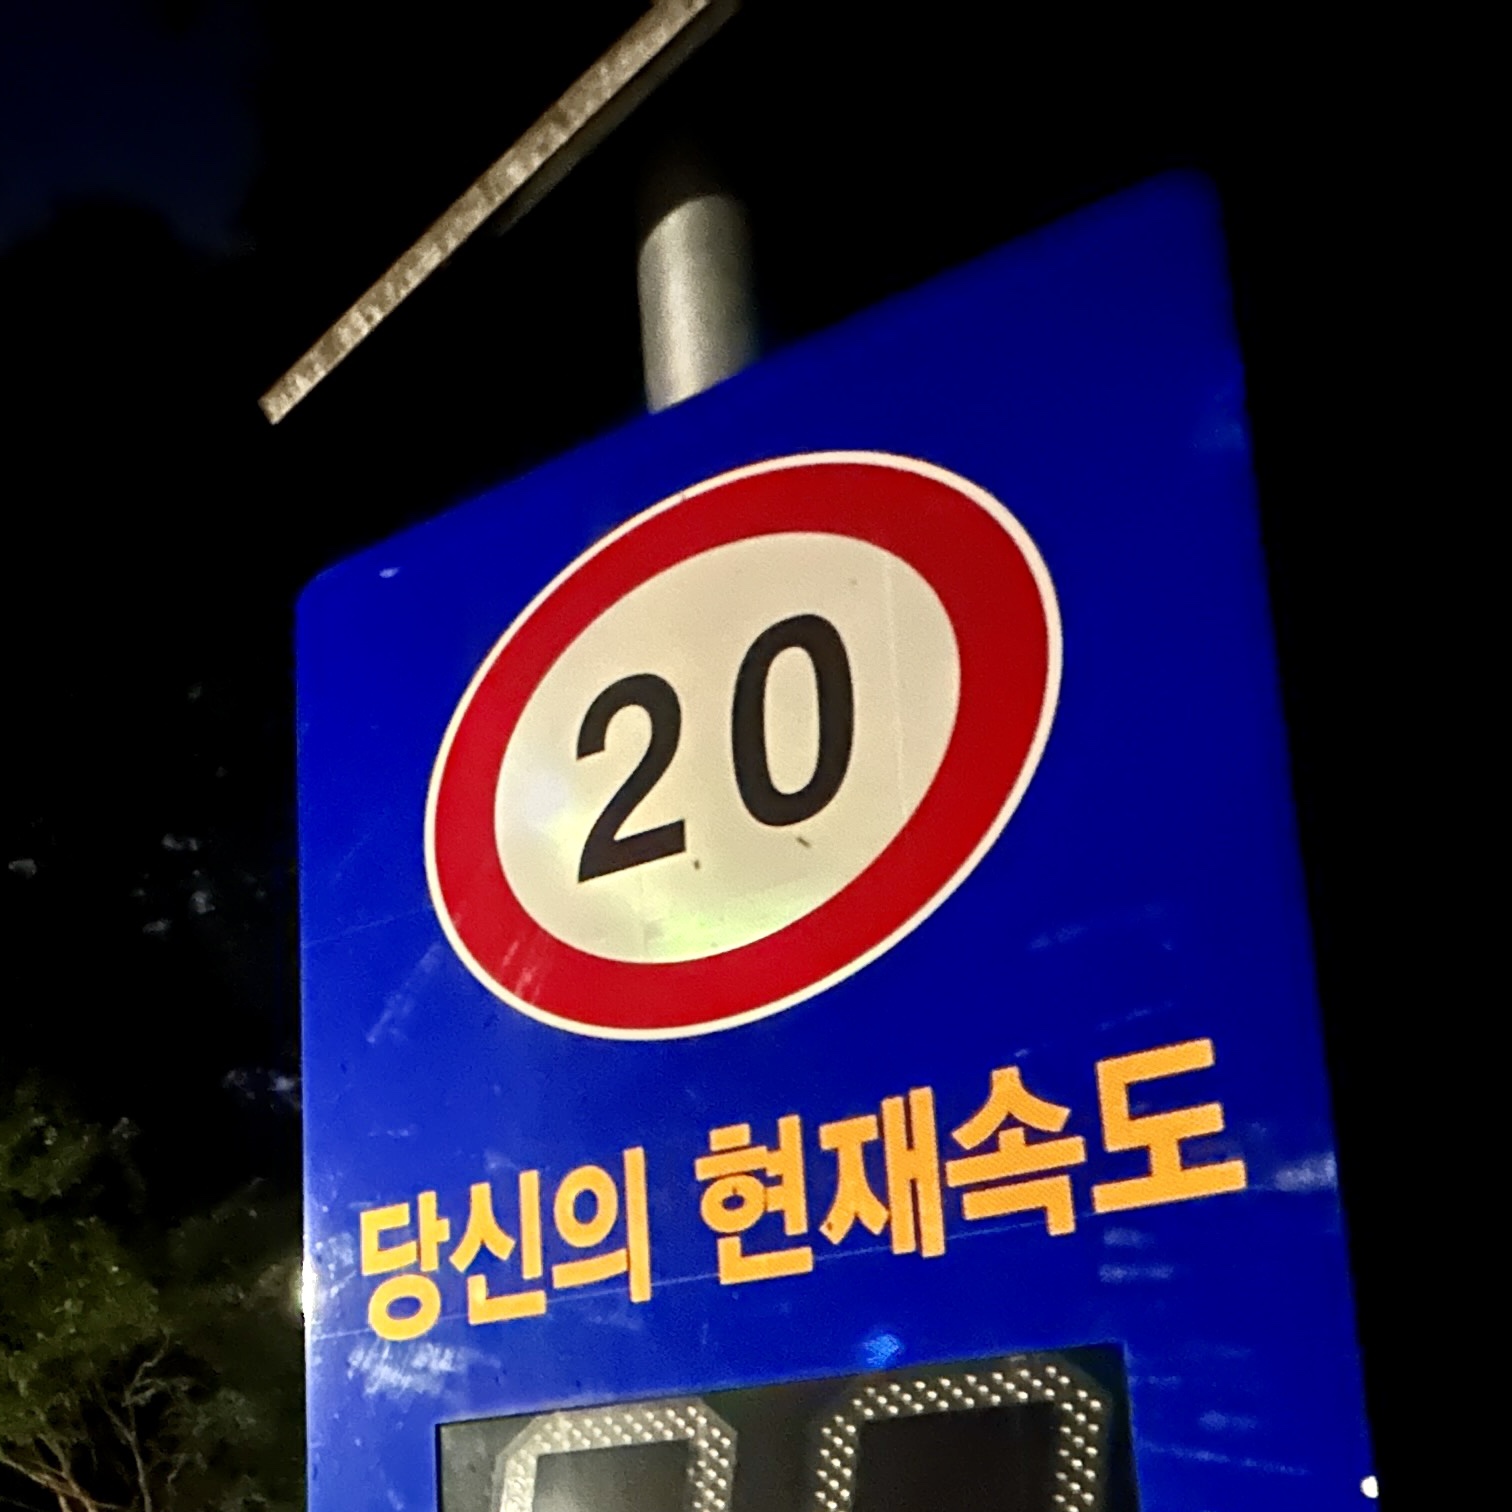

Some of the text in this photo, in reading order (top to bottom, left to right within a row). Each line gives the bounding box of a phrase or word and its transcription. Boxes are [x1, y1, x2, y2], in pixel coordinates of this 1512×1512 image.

[575, 613, 856, 884] 20
[359, 1037, 1248, 1341] 당신의 현재속도
